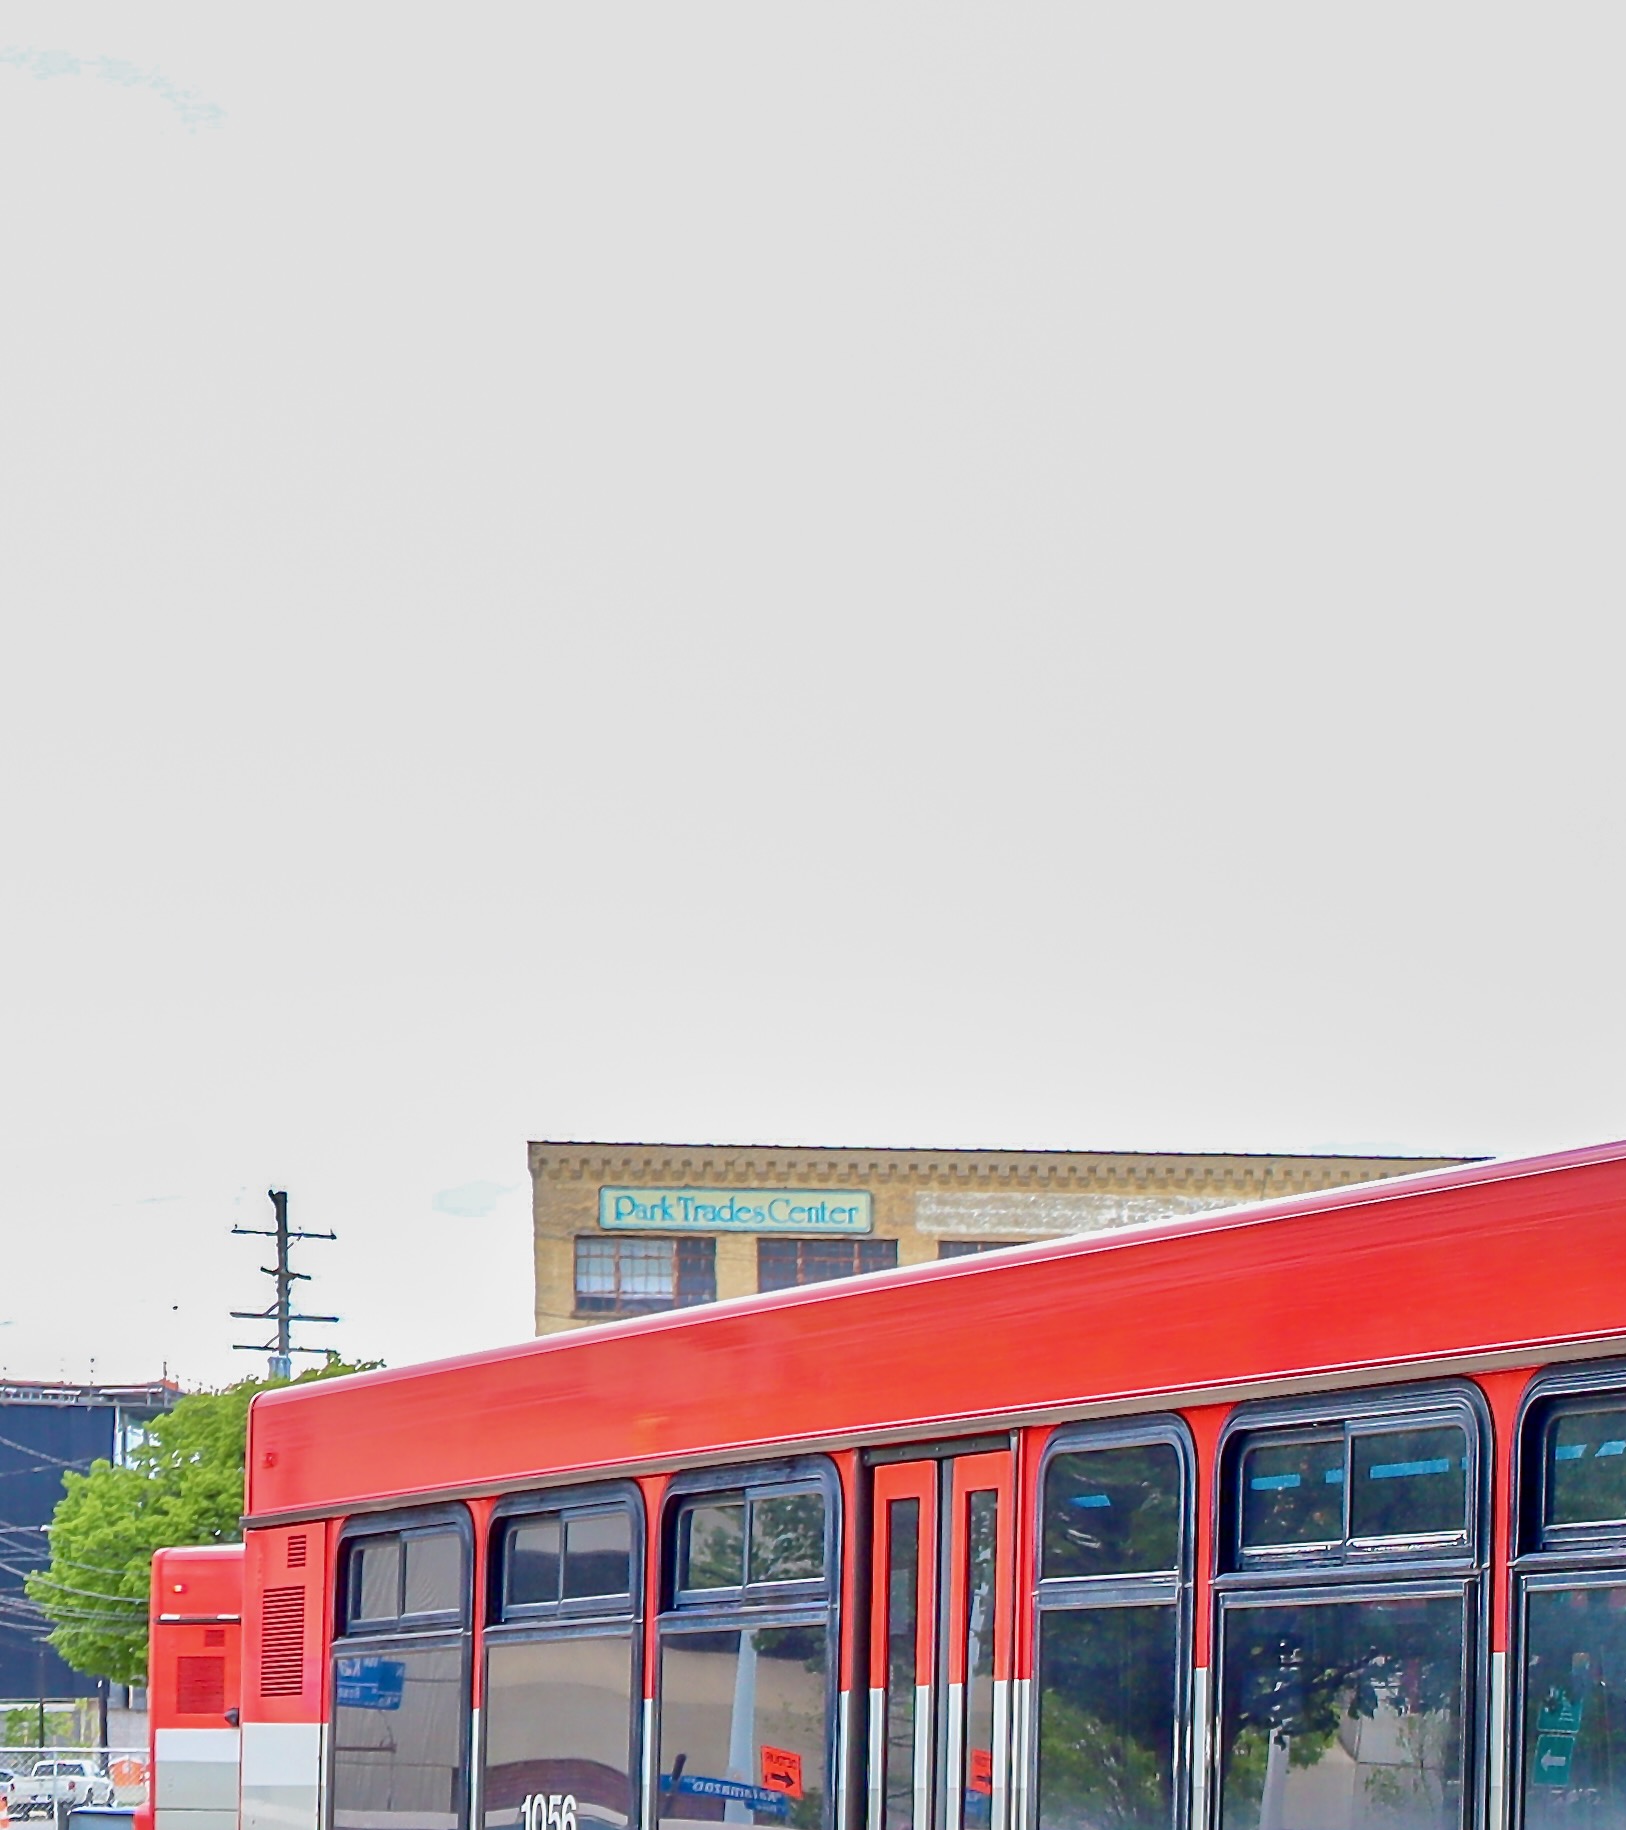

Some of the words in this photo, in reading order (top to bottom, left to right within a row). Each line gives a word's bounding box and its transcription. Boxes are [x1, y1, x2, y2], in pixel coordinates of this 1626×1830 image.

[614, 1195, 673, 1222] Park
[677, 1196, 766, 1224] Trades
[768, 1197, 859, 1225] Center
